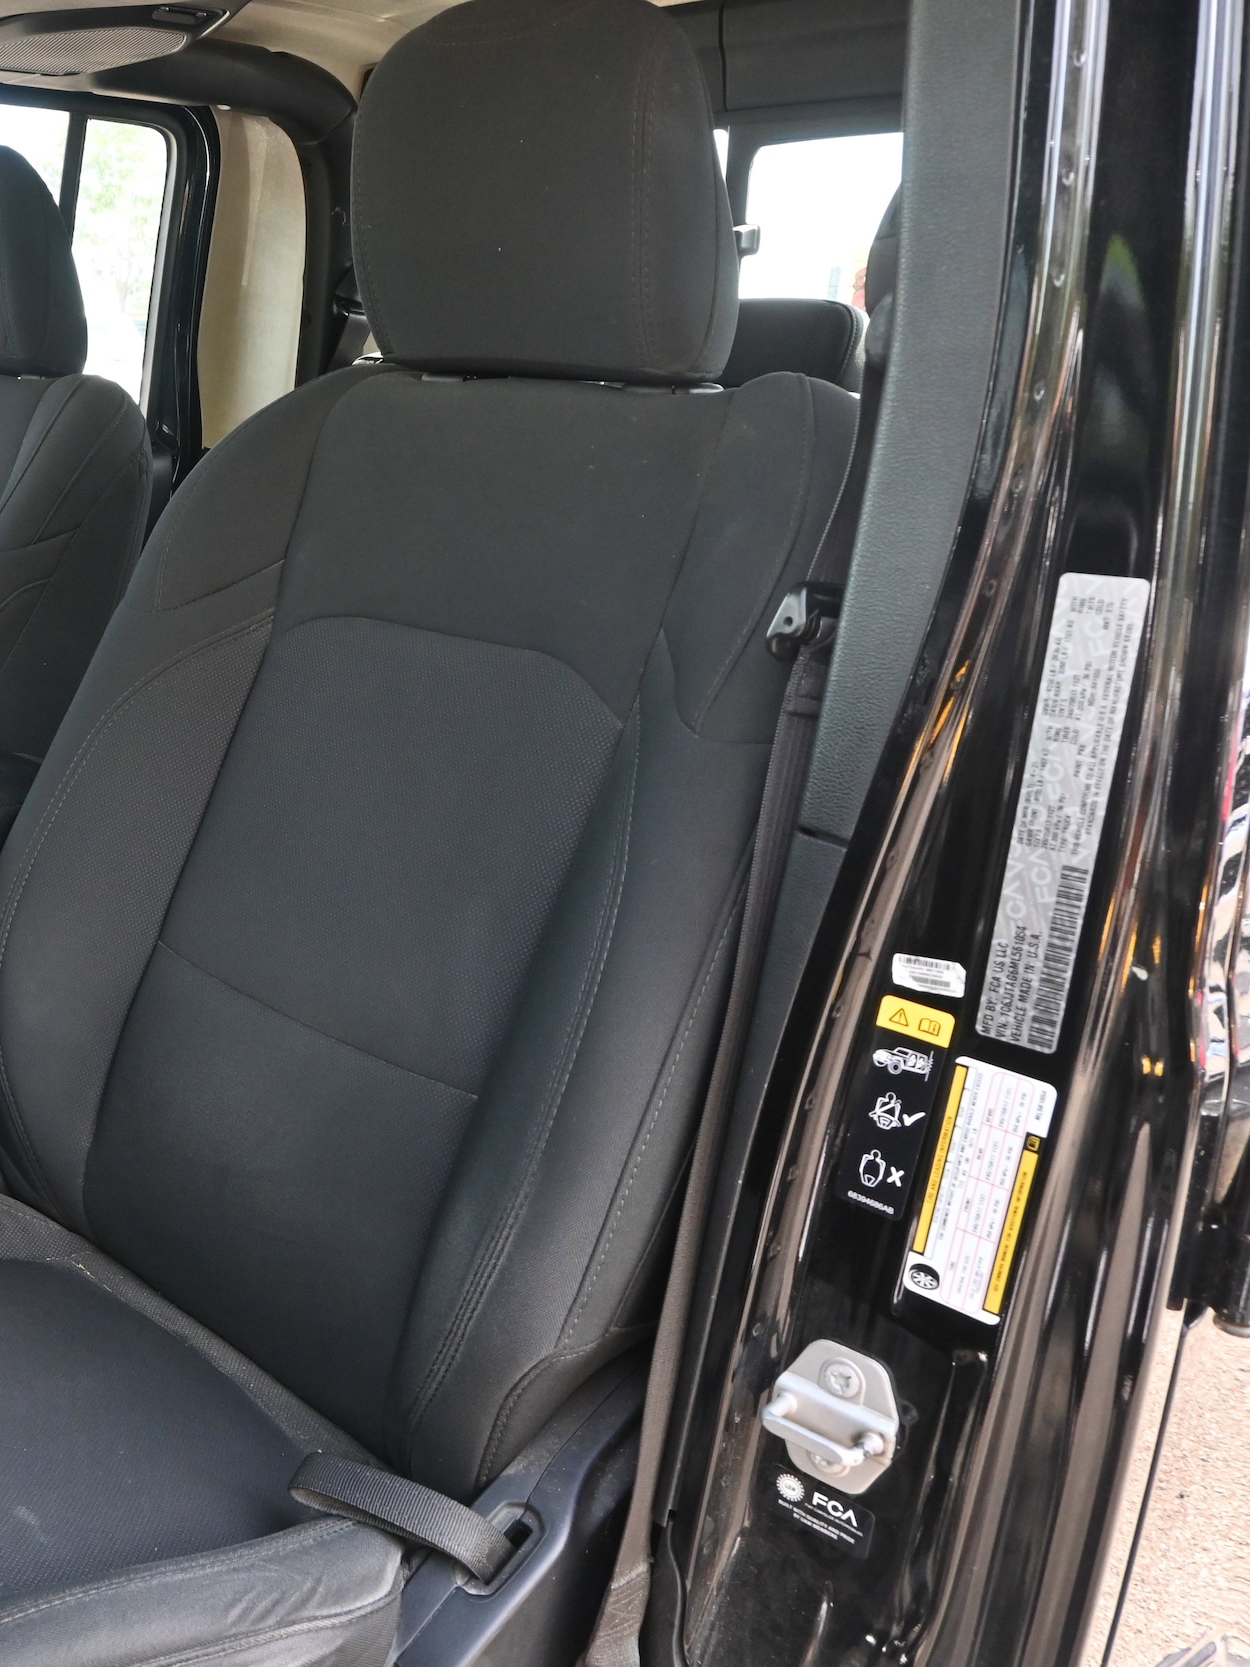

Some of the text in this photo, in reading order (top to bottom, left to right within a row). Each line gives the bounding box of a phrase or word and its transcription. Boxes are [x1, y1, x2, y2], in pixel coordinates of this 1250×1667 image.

[981, 941, 1009, 1035] MFD BY: FCA US LLC
[1010, 930, 1042, 1043] VEHICLE MADE IN: U.S.A.
[995, 1019, 1009, 1039] VIN:
[932, 1154, 943, 1178] LOADING
[938, 1116, 952, 1153] INFORMATION
[812, 1491, 858, 1527] FCA
